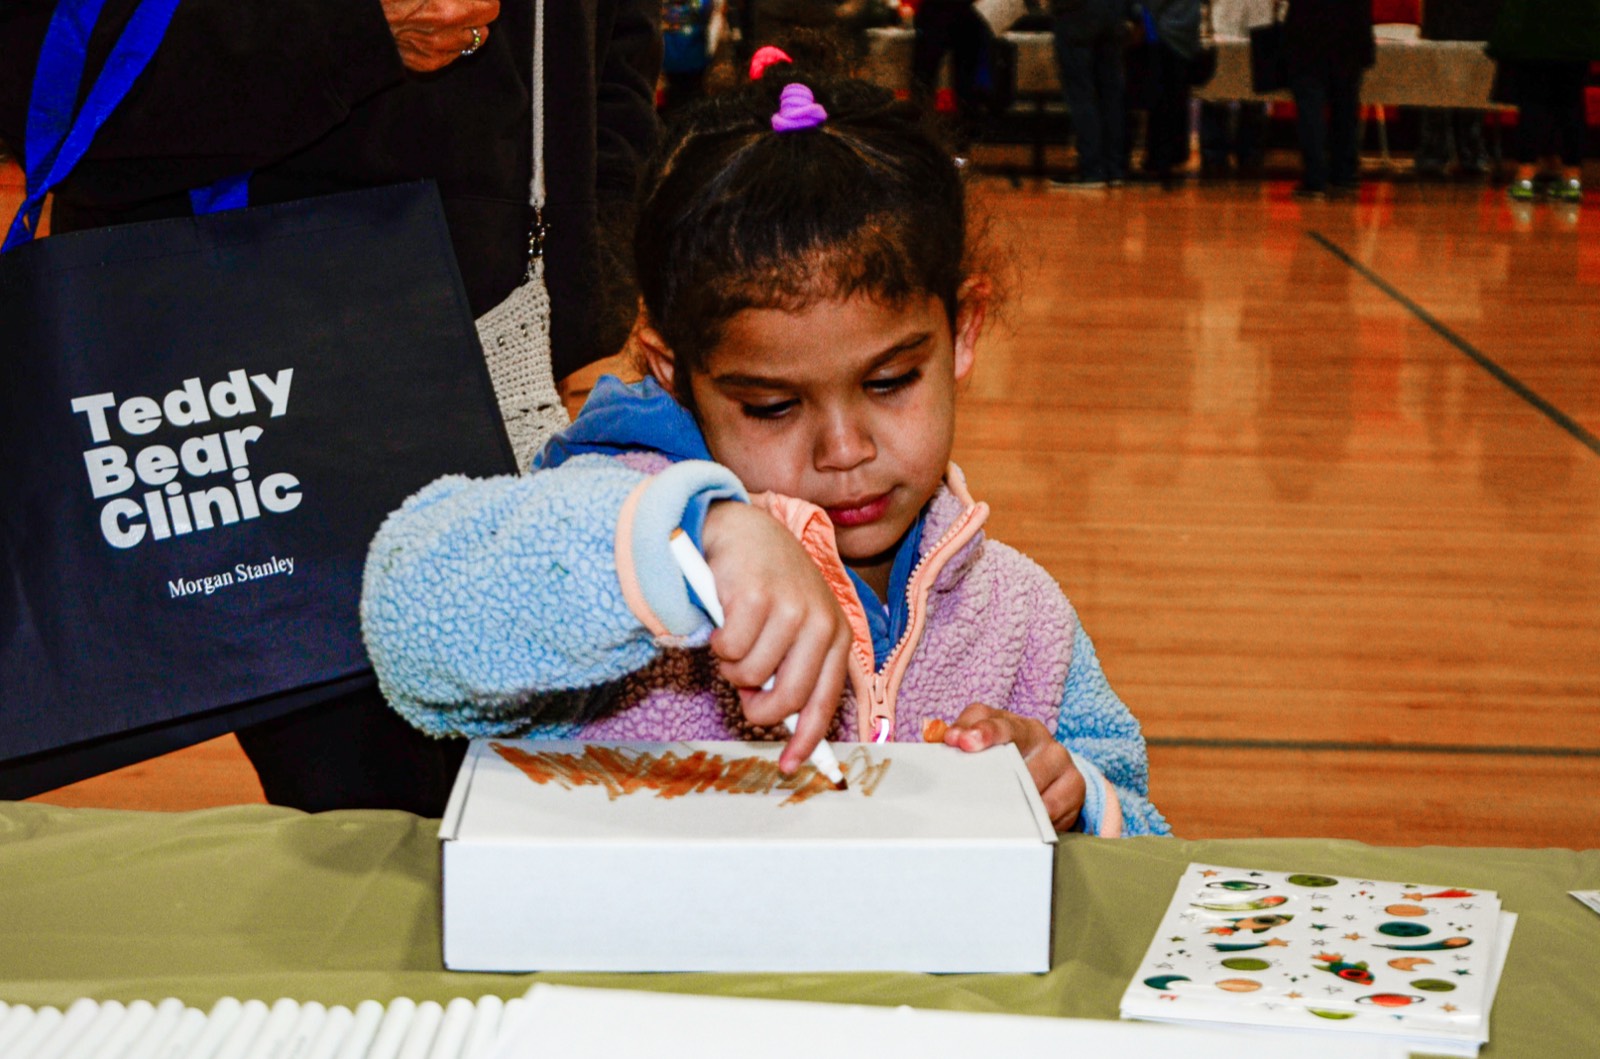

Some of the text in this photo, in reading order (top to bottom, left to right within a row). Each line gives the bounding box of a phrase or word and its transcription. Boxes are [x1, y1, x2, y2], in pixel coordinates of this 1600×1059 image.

[71, 368, 294, 443] Teddy
[83, 425, 264, 499] Bear
[100, 467, 303, 549] Clinic
[168, 556, 295, 598] Morgan Stanley
